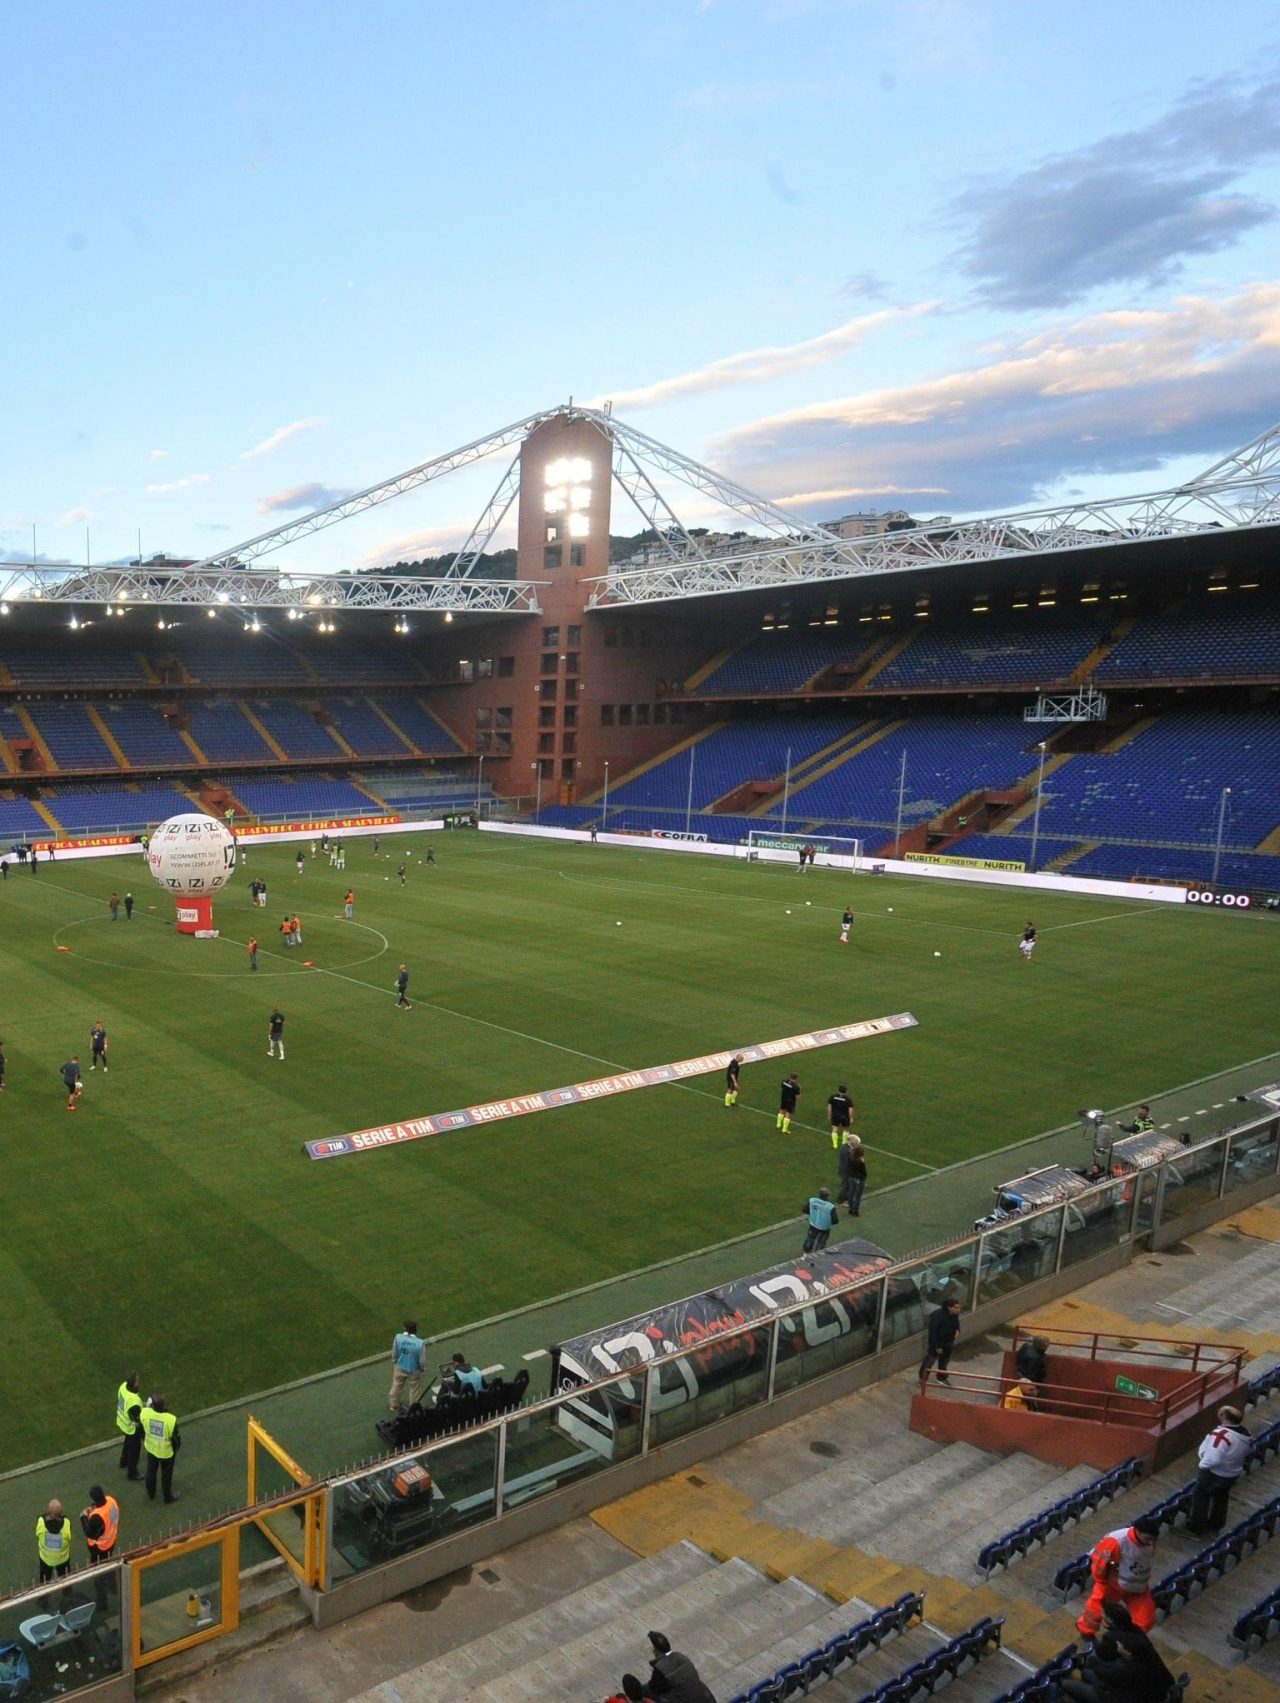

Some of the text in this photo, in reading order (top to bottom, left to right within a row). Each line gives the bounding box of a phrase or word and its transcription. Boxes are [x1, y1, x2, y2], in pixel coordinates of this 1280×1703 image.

[300, 822, 337, 831] OTTICA
[661, 832, 706, 842] COFRA
[906, 853, 1022, 871] NURITH FINESTRE NURITH
[1187, 891, 1249, 907] 00:00
[674, 1058, 707, 1076] SERIE
[577, 1074, 645, 1098] SERIE A TIM
[560, 1092, 573, 1101] TIM
[470, 1096, 545, 1121] SERIE A TIM
[452, 1115, 465, 1124] TIM
[352, 1120, 434, 1148] SERIE A TIM
[328, 1142, 345, 1151] TIM
